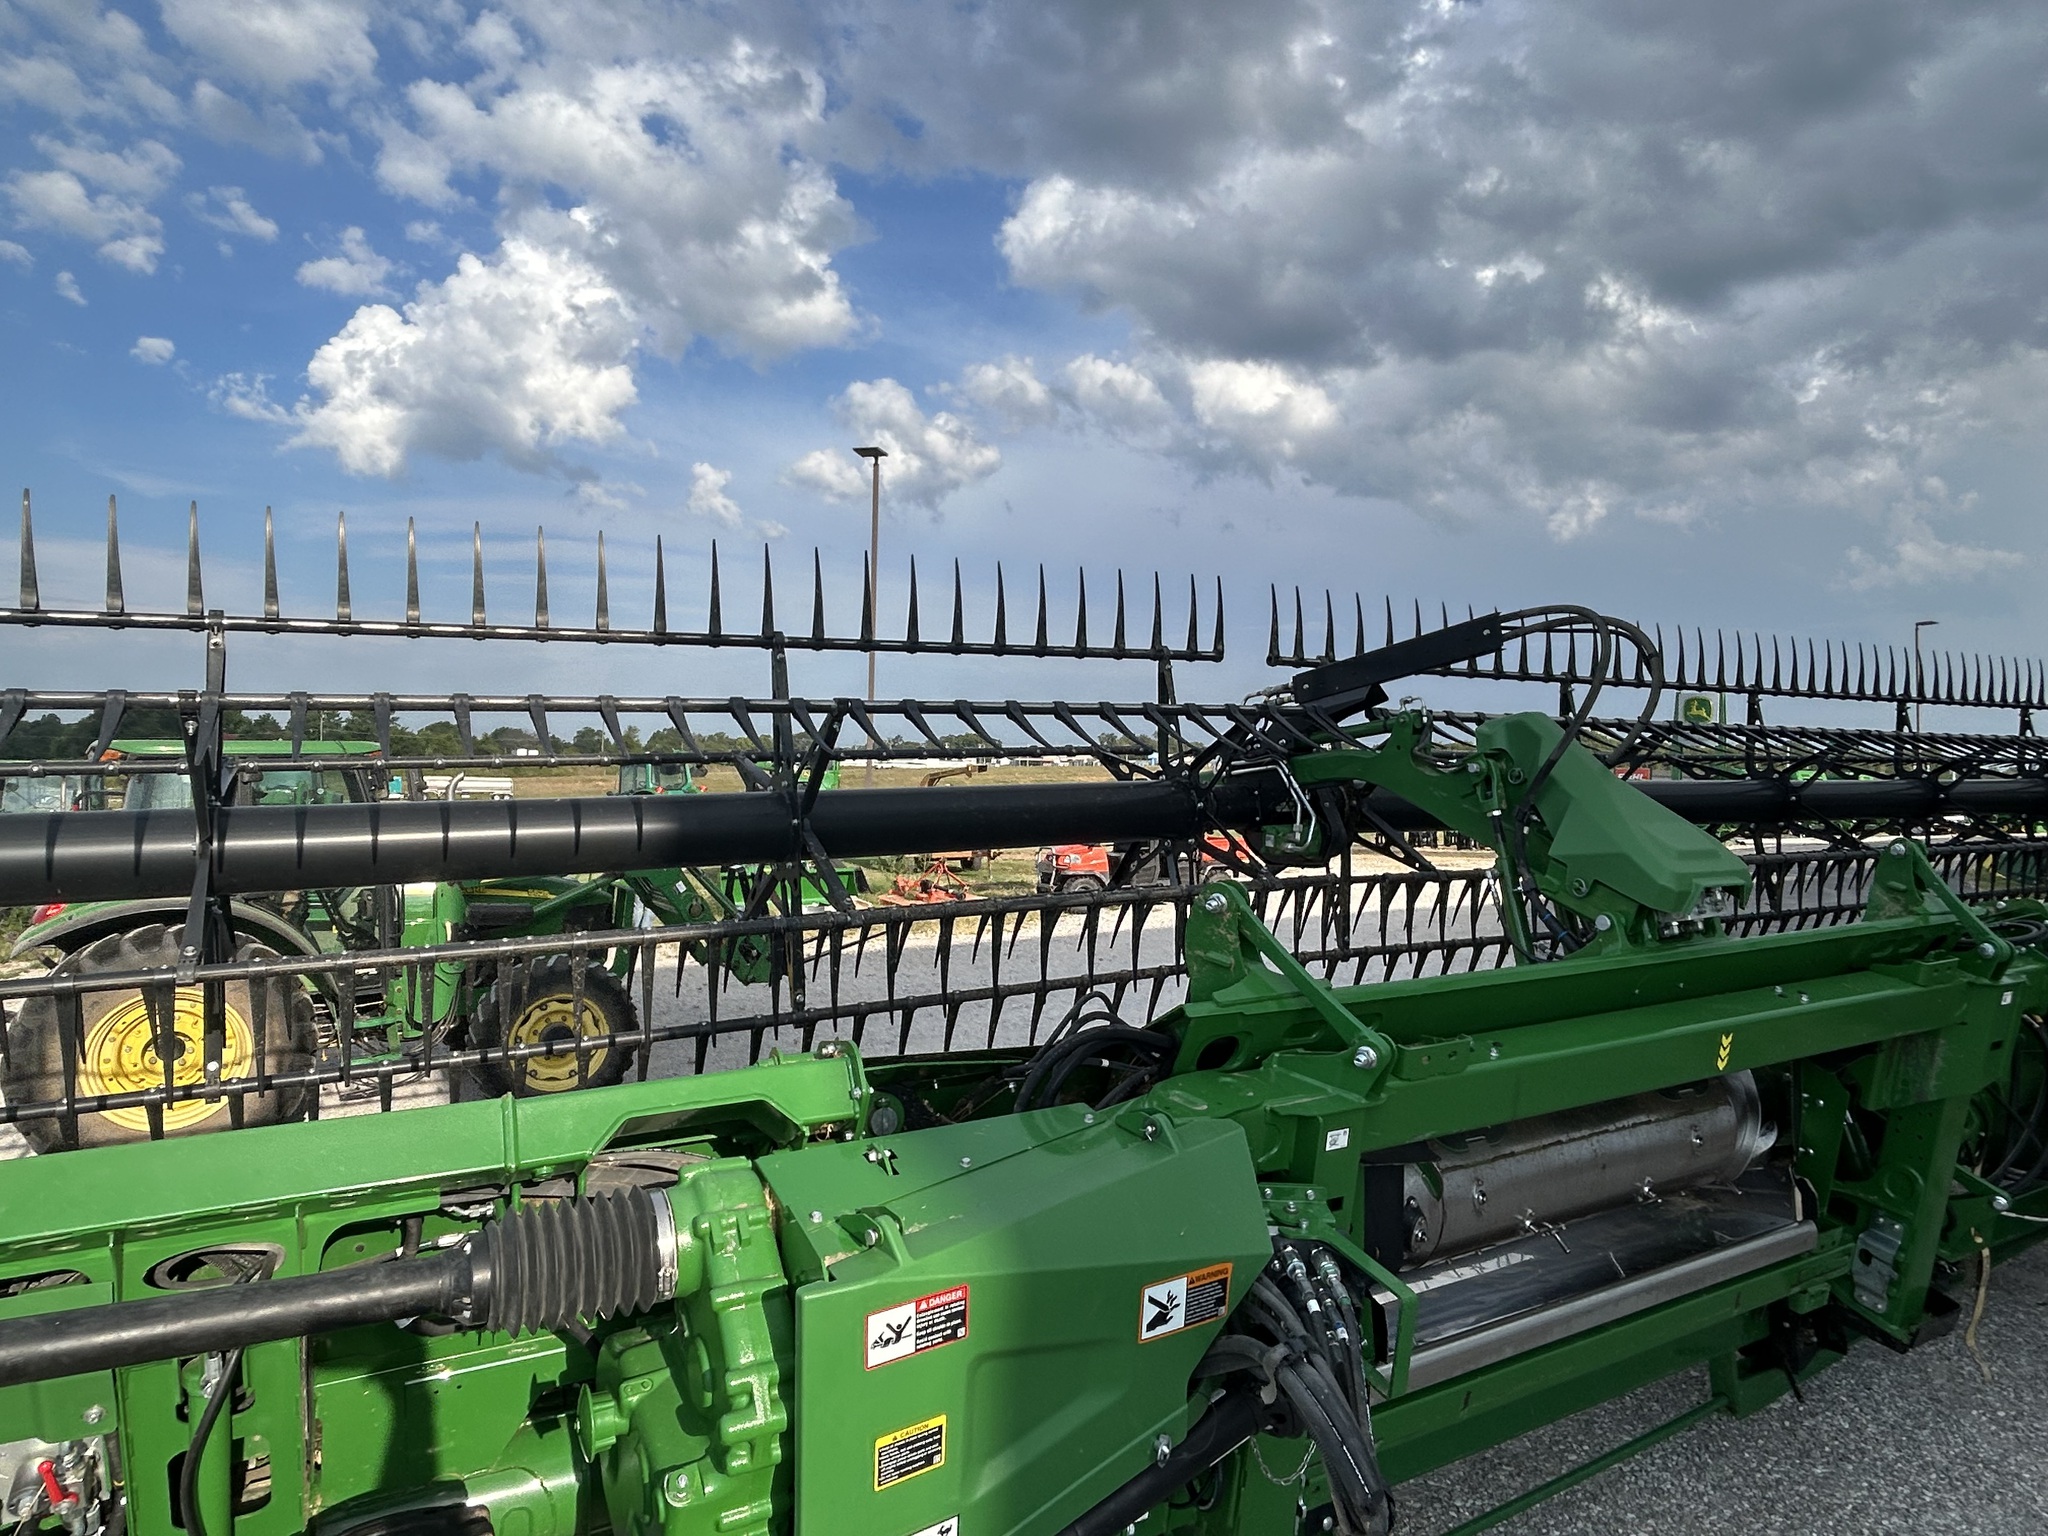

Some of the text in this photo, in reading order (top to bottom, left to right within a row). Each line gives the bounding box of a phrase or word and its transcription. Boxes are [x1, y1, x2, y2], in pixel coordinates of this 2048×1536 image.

[1194, 1267, 1229, 1282] WARNING
[928, 1290, 963, 1307] DANGER
[899, 1423, 930, 1438] CAUTION
